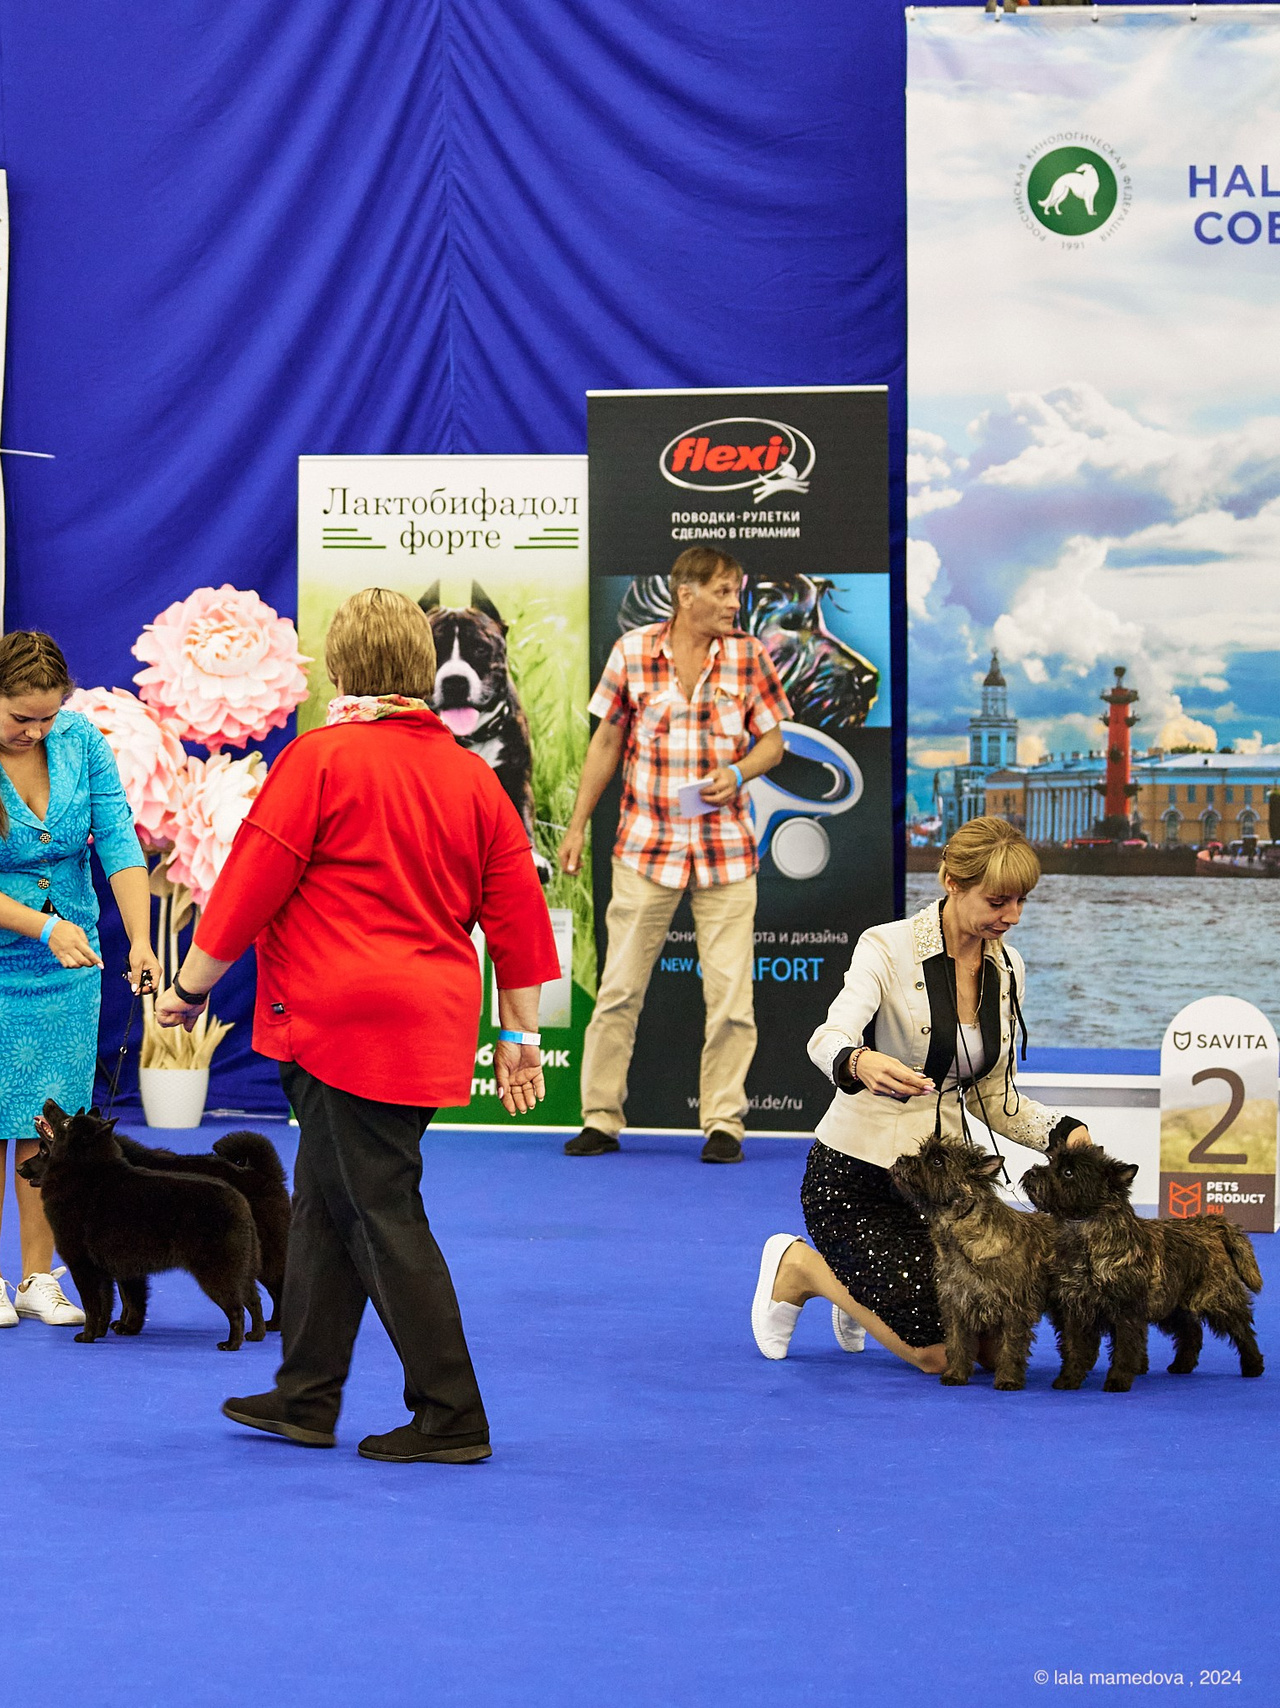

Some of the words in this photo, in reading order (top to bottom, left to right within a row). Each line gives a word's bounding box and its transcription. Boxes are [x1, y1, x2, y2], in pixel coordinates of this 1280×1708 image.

[1061, 240, 1085, 250] 1991
[671, 435, 783, 472] flexi
[323, 487, 579, 522] Лактобифадол
[400, 520, 501, 555] форте
[671, 528, 727, 541] СДЕЛАНО
[729, 528, 737, 539] В
[739, 527, 801, 540] ГЕРМАНИИ
[779, 932, 788, 943] и
[791, 929, 849, 945] дизайна
[661, 957, 694, 972] NEW
[1197, 1034, 1268, 1050] SAVITA
[1188, 1067, 1248, 1165] 2
[1206, 1182, 1239, 1192] PETS
[1206, 1193, 1266, 1204] PRODUCT
